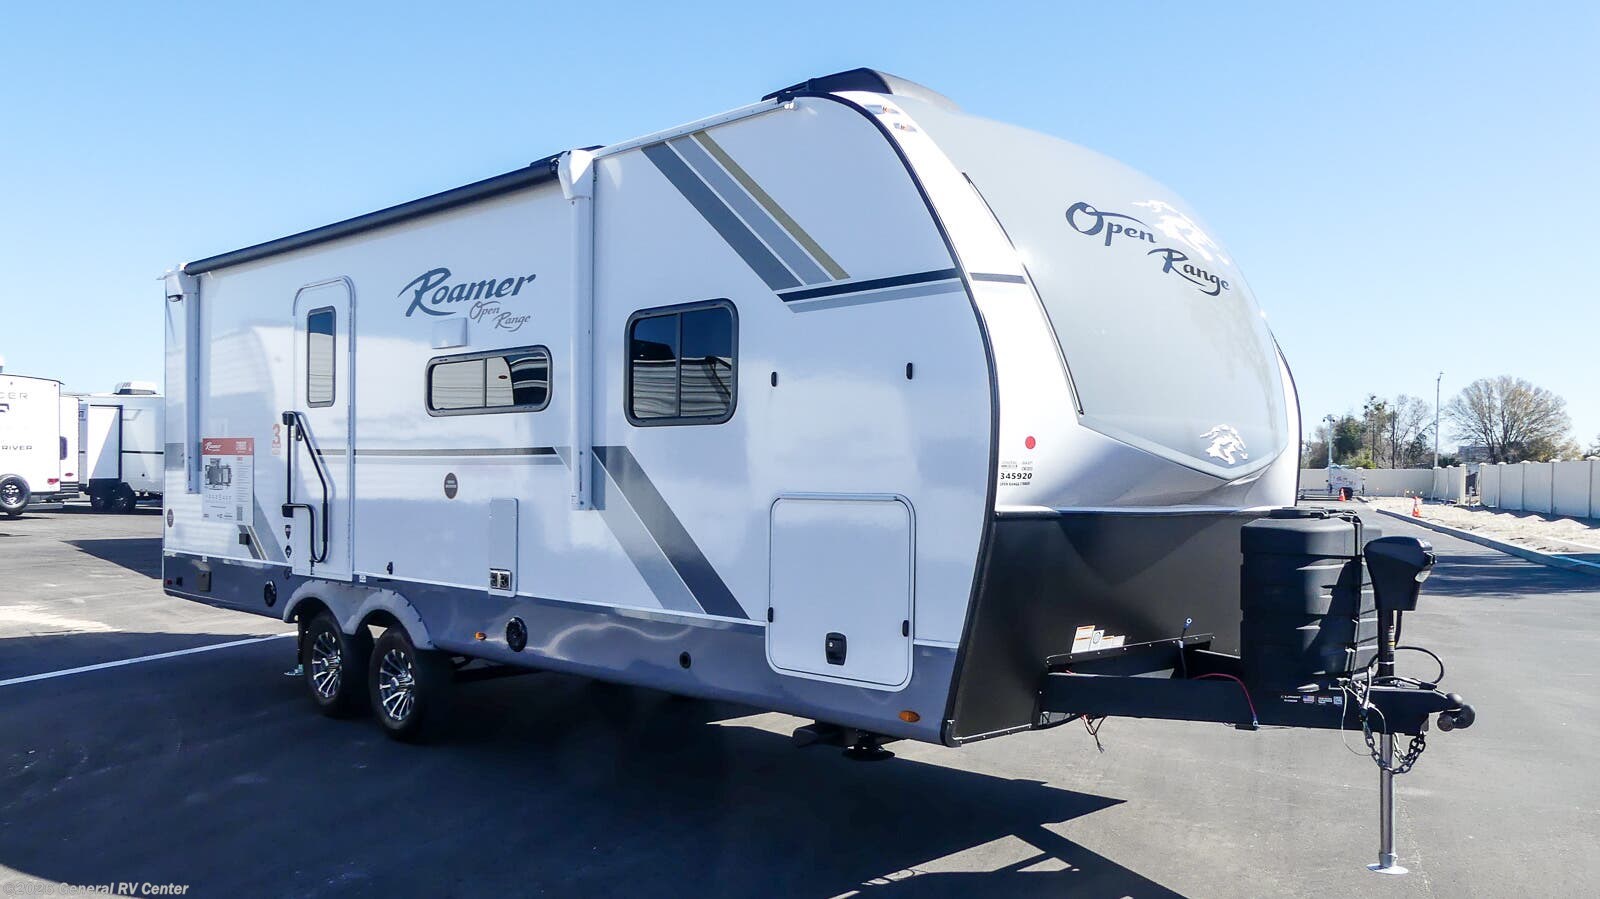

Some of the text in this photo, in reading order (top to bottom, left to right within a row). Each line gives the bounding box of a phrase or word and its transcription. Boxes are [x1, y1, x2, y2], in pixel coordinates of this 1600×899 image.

[1065, 201, 1158, 247] Open
[1147, 247, 1231, 297] Range
[397, 267, 537, 317] Roamer
[469, 300, 502, 324] Open
[492, 311, 532, 333] Range
[1000, 472, 1033, 480] 345920
